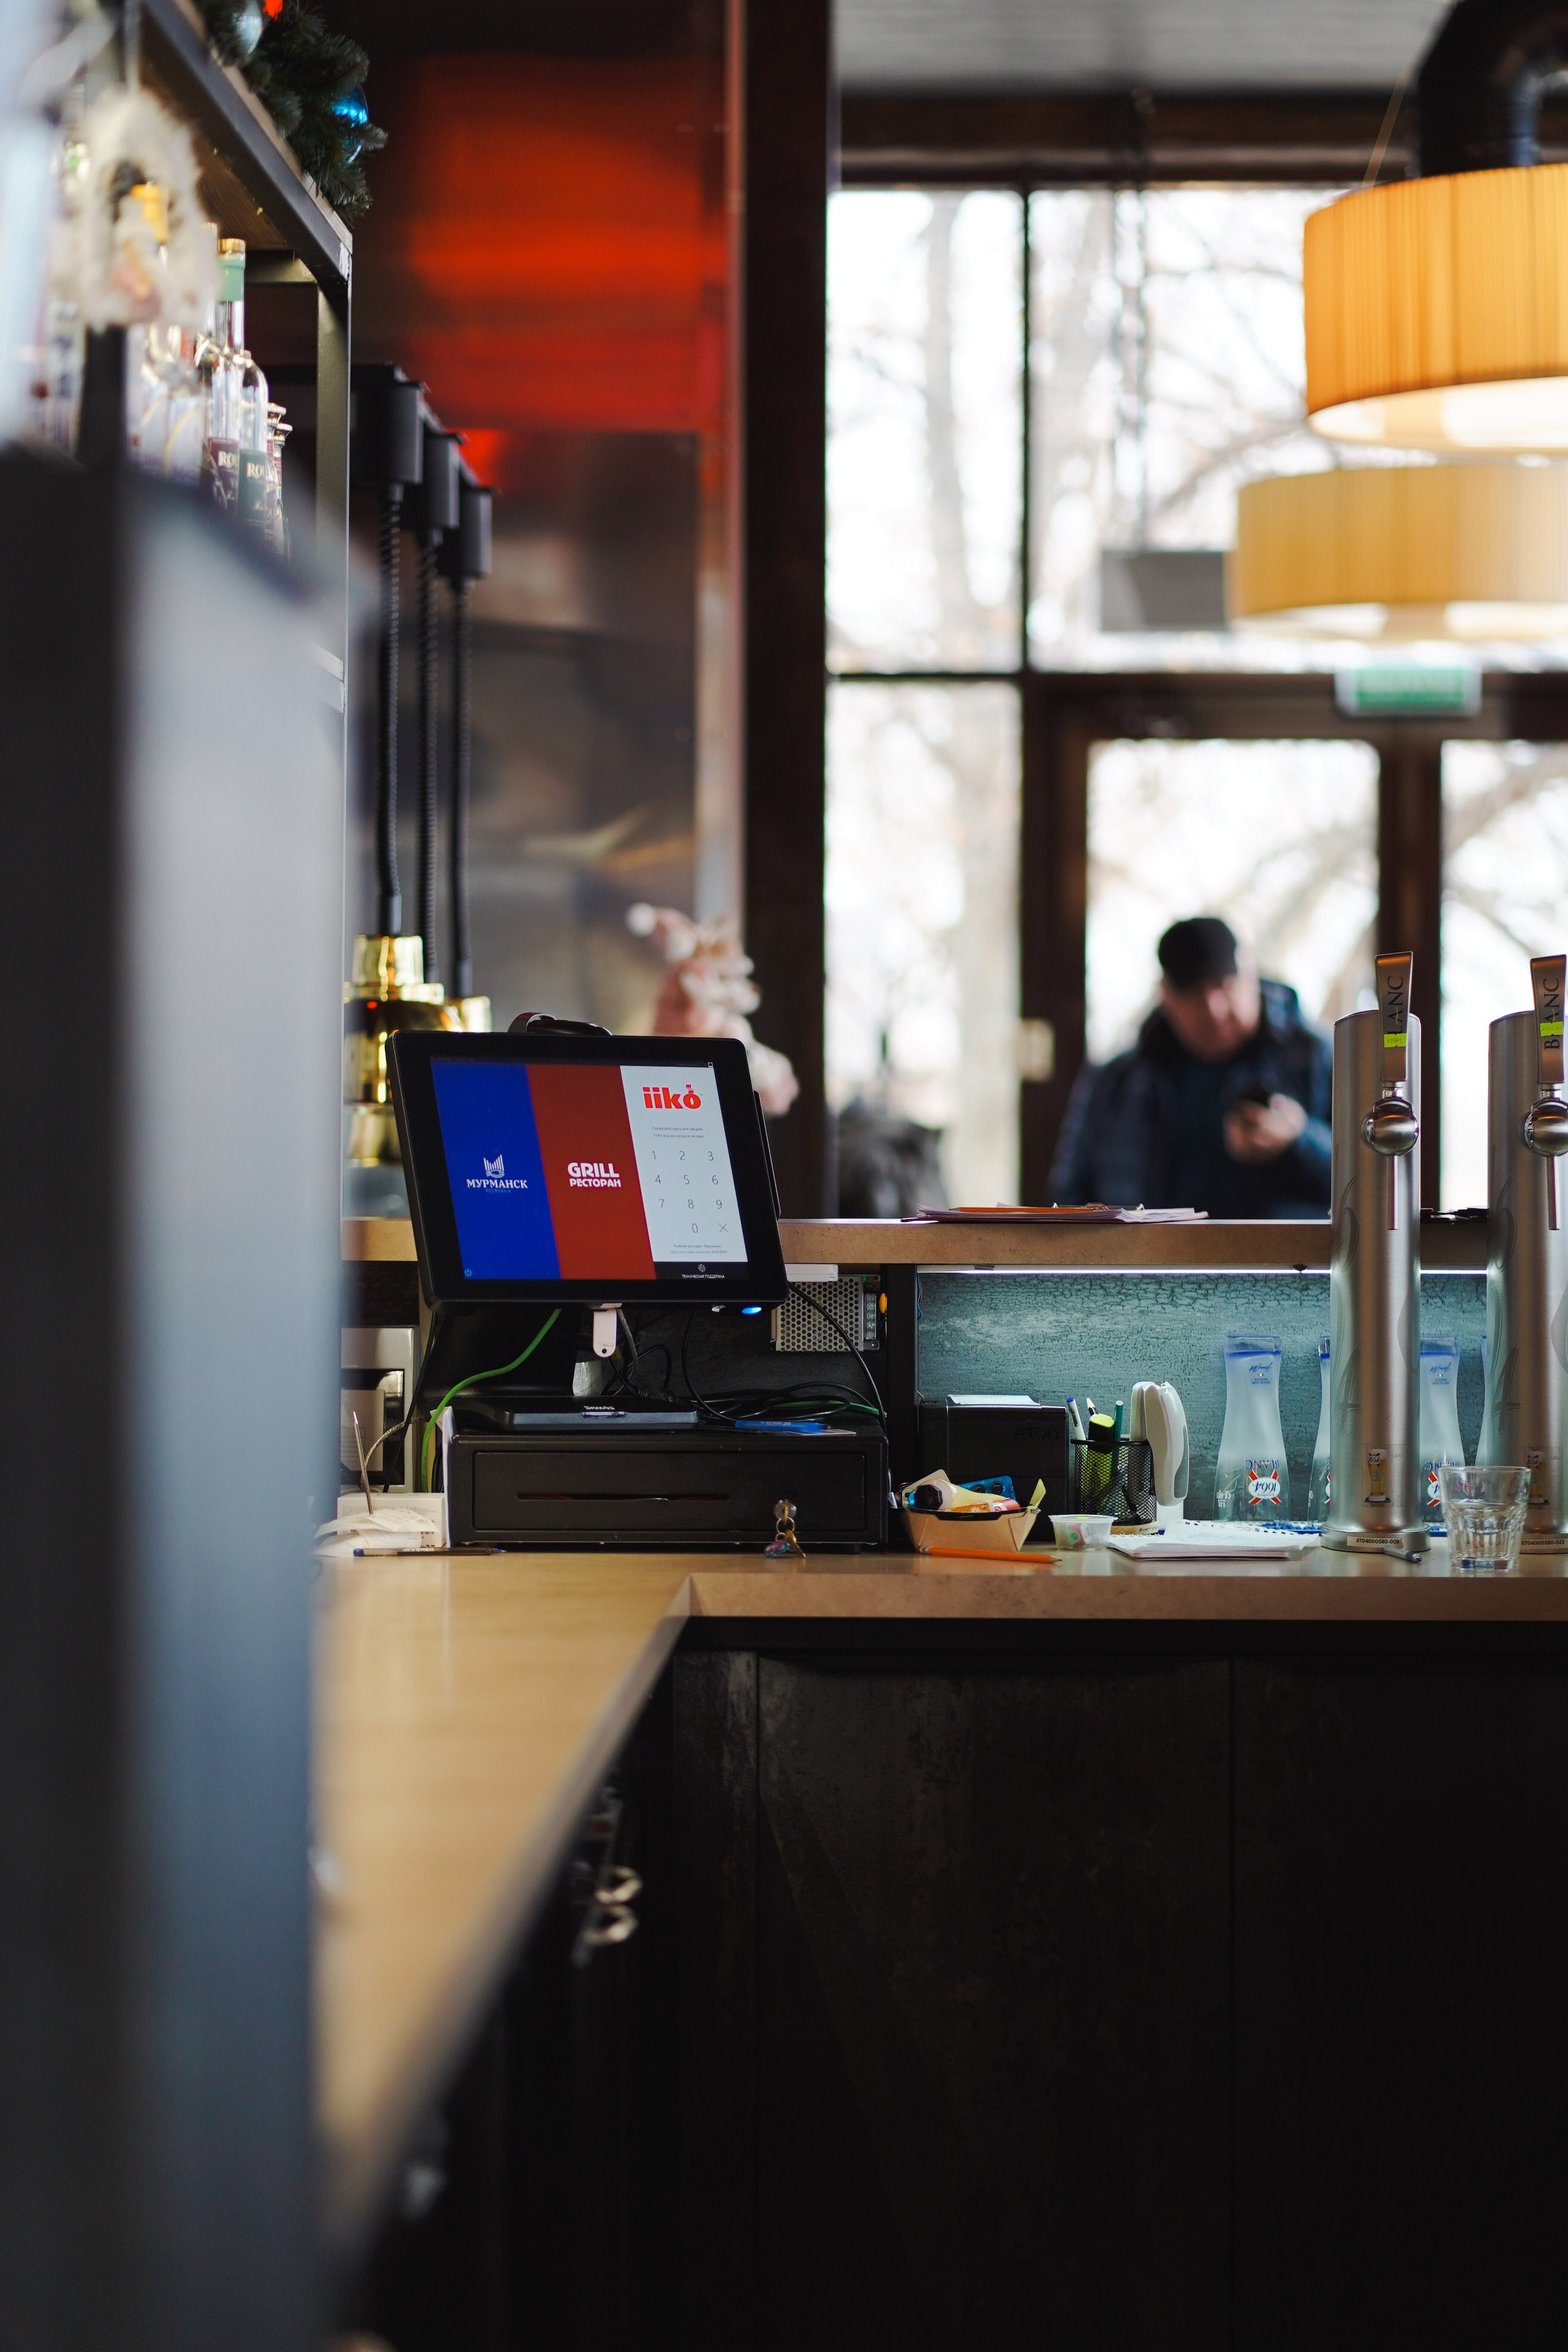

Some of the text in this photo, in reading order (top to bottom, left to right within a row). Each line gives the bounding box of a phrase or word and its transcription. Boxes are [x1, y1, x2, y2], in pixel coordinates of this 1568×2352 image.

[1387, 975, 1403, 1035] LANC
[643, 1084, 701, 1110] iiko
[651, 1150, 714, 1161] 1 2 3
[567, 1162, 620, 1178] GRILL
[466, 1178, 528, 1189] МУРМАНСК
[569, 1178, 622, 1188] РЕСТОРАН
[655, 1174, 718, 1185] 4 5 6
[658, 1199, 723, 1210] 7 8 9
[692, 1223, 698, 1234] 0
